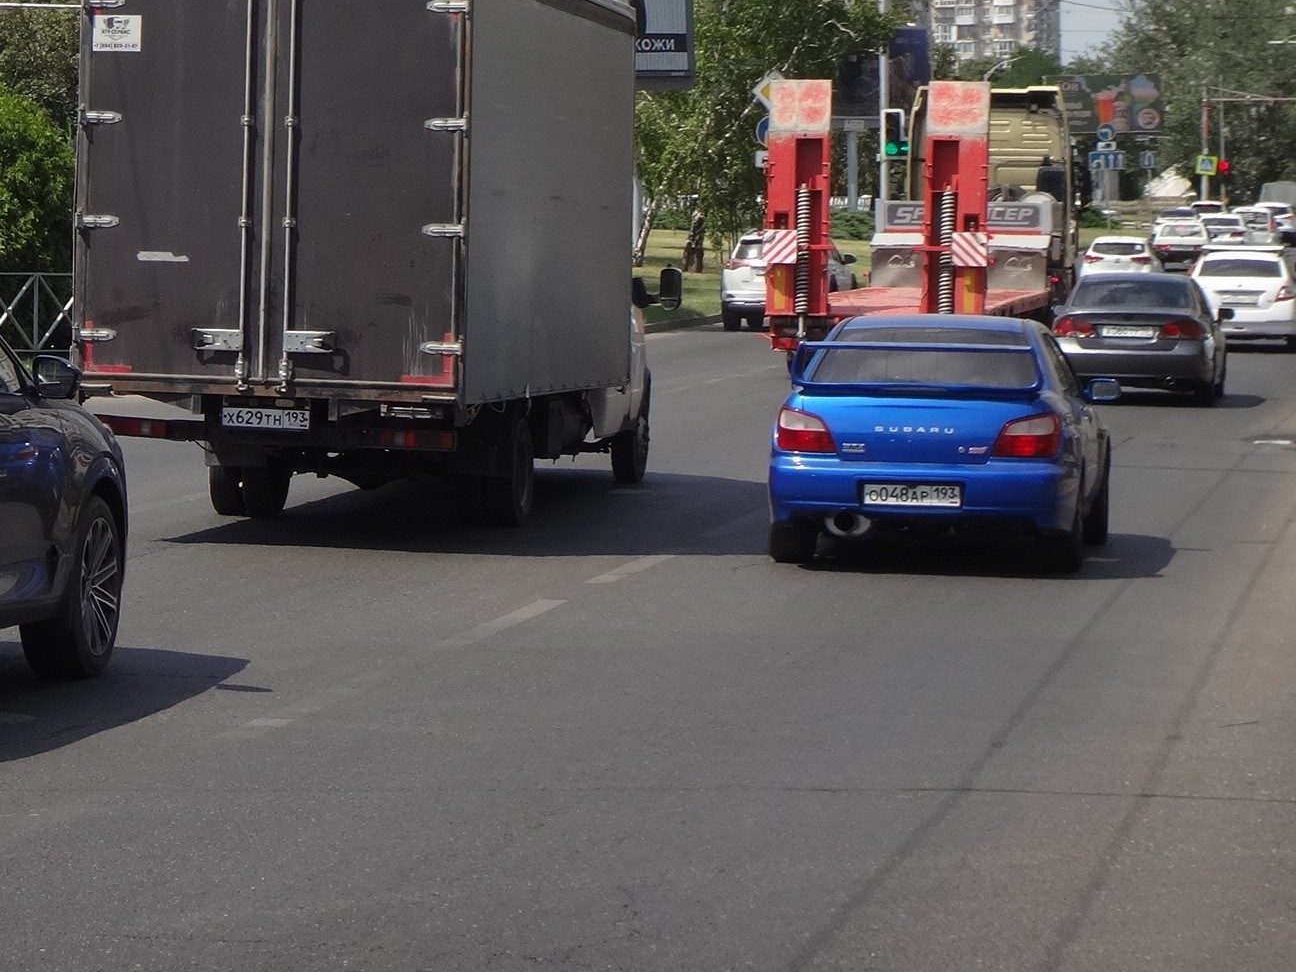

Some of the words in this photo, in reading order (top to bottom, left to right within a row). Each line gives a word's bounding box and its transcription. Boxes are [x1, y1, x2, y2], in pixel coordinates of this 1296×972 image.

[227, 410, 282, 426] Х629ТН
[285, 411, 306, 423] 193
[874, 425, 954, 434] SUBARU
[869, 487, 930, 503] О048АР
[933, 487, 956, 499] 193
